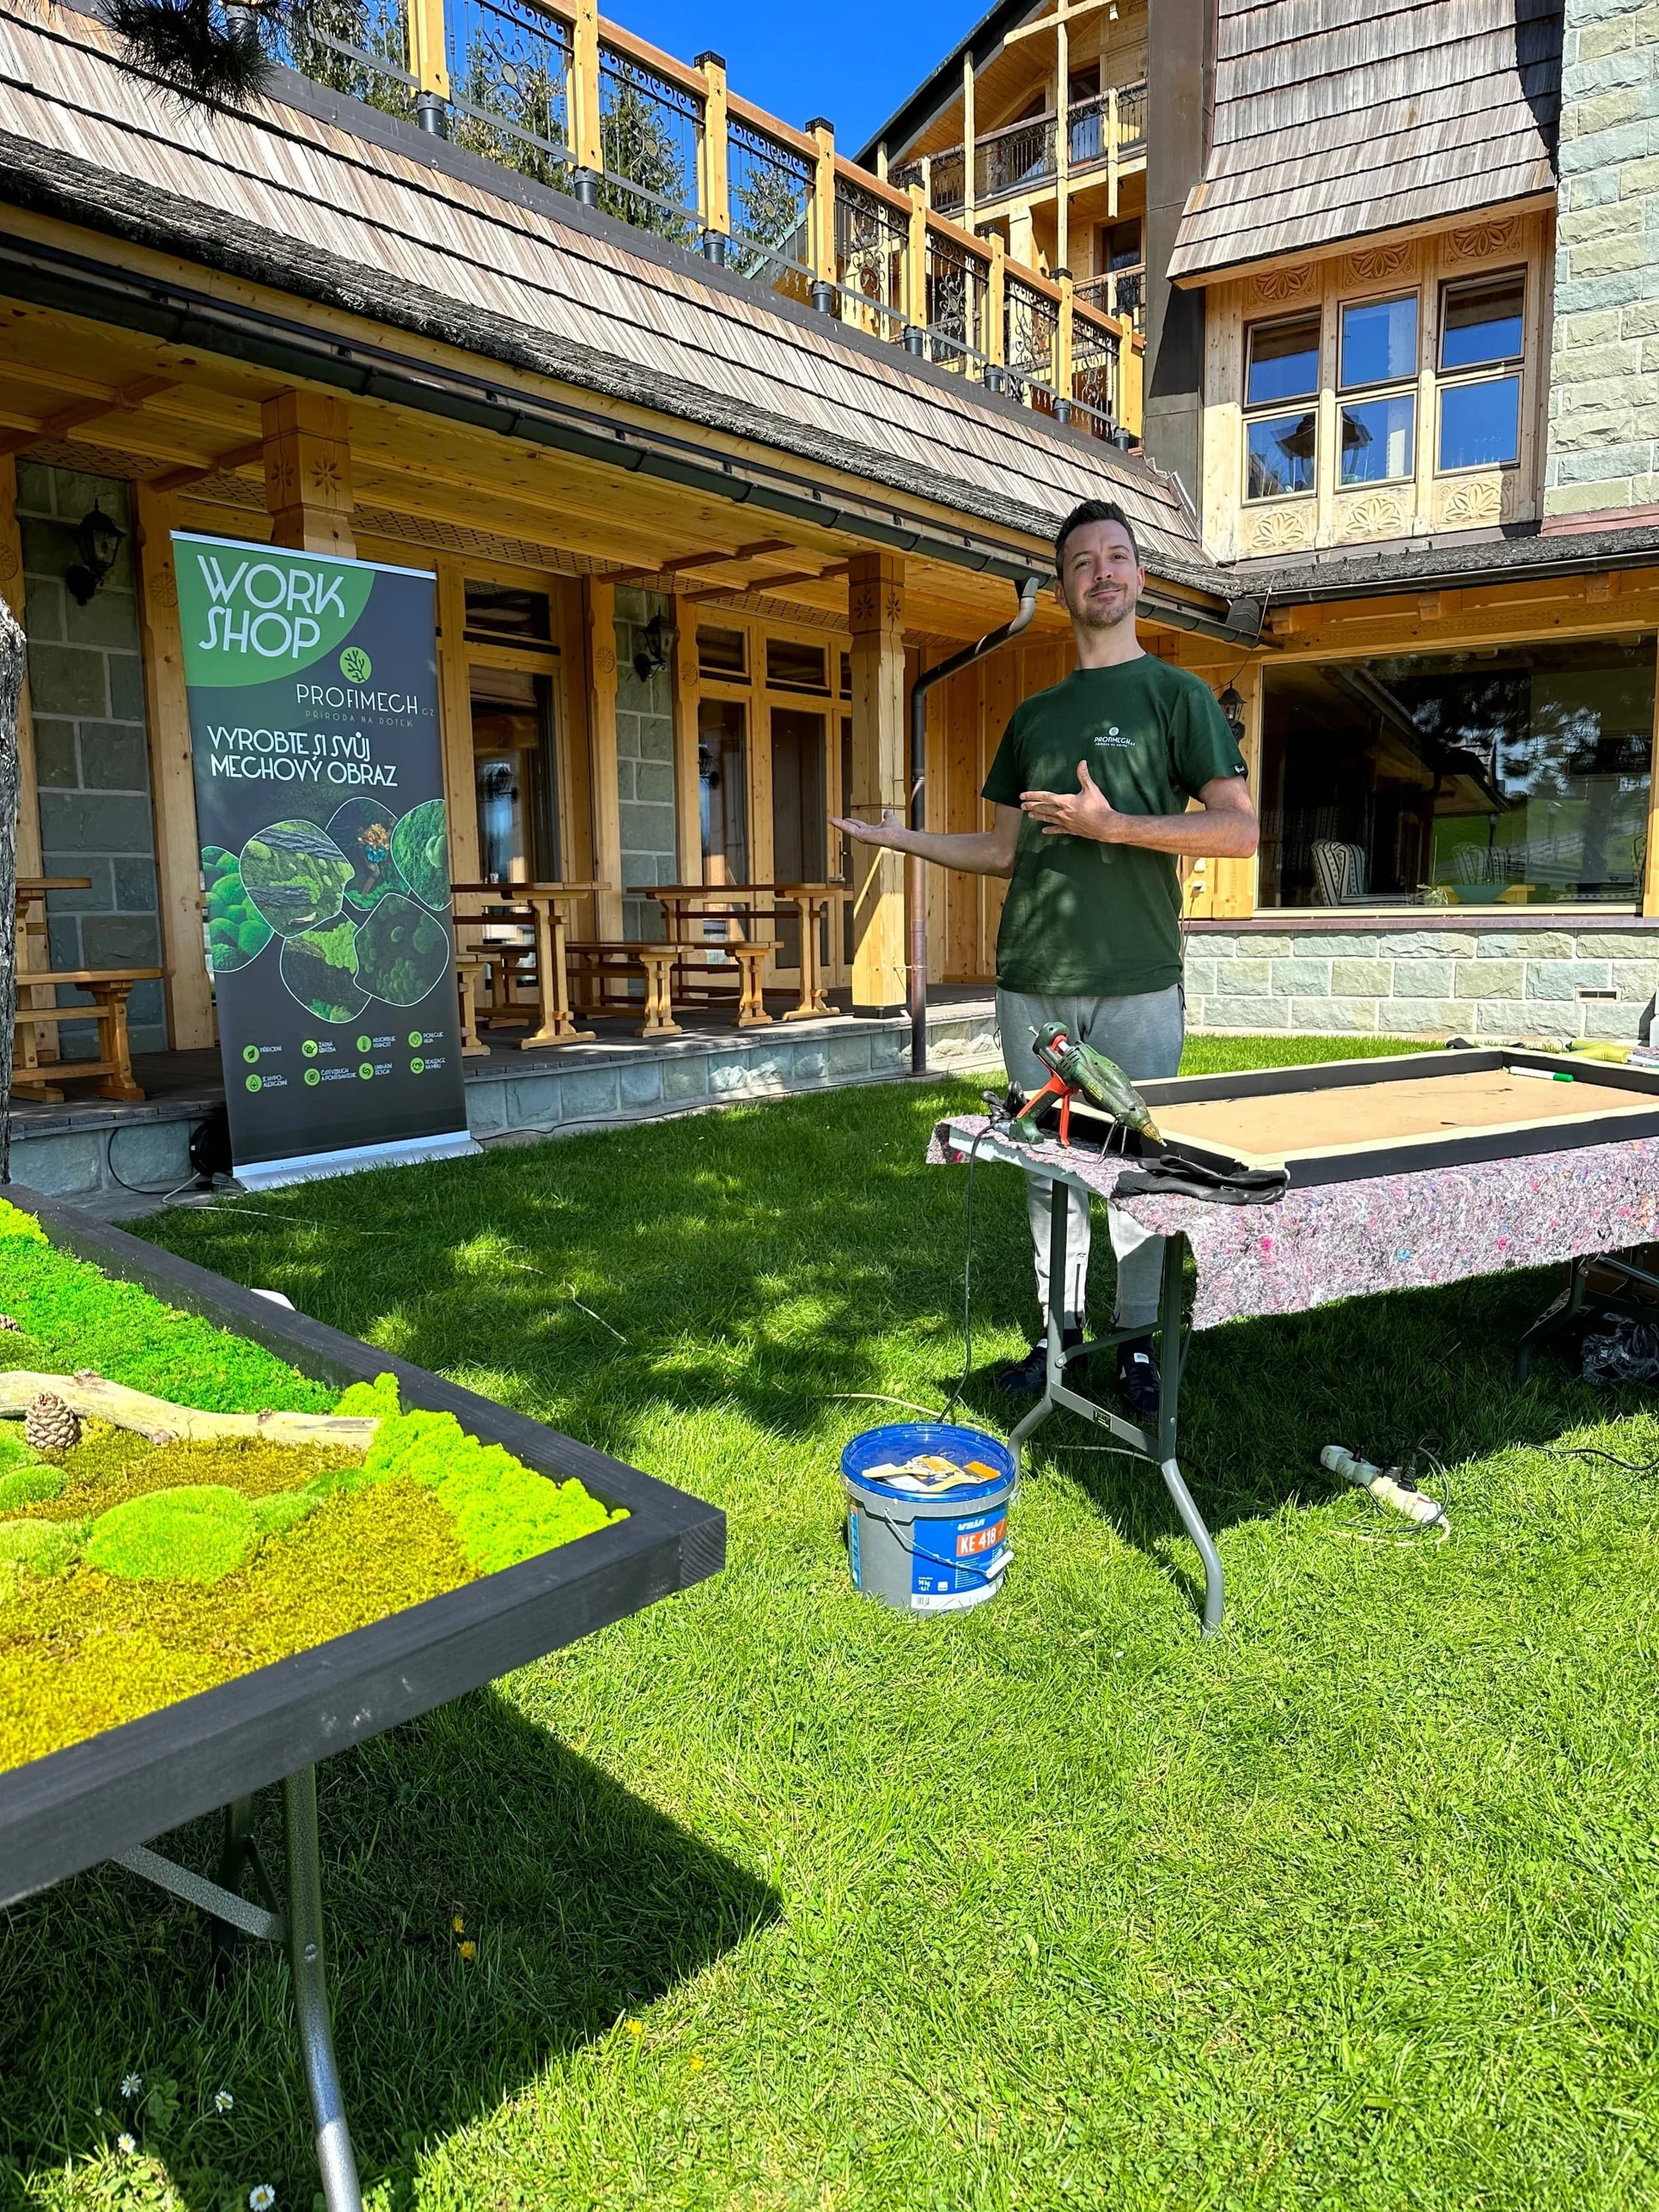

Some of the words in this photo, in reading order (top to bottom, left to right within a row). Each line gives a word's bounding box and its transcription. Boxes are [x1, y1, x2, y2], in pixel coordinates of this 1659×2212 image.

[197, 555, 345, 618] WORK
[198, 606, 321, 659] SHOP
[296, 684, 418, 714] PROFIMECH
[379, 717, 413, 727] DOTEK
[207, 725, 309, 755] VYROBTE
[312, 733, 327, 757] SI
[330, 731, 371, 763] SVŮJ
[211, 753, 323, 782] MECHOVÝ
[327, 761, 398, 787] OBRAZ
[961, 1535, 975, 1554] KE
[978, 1527, 997, 1549] 418
